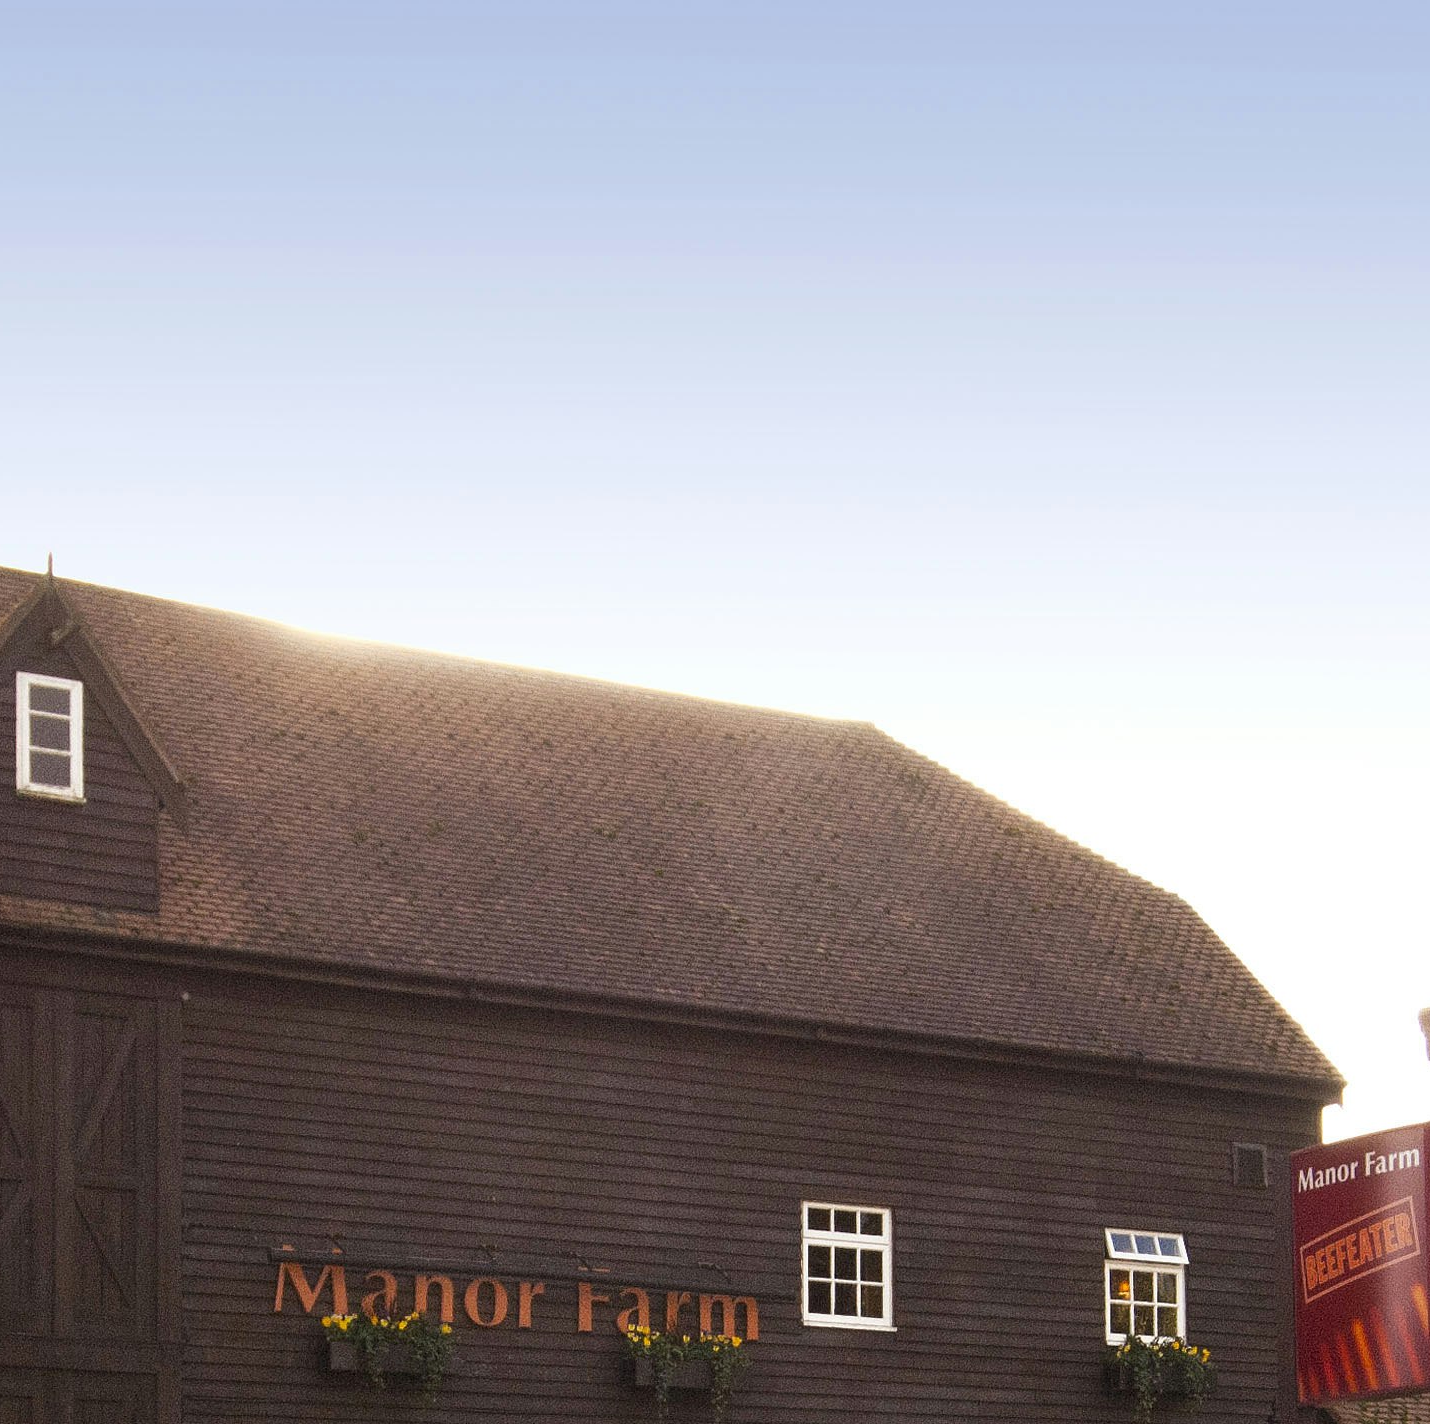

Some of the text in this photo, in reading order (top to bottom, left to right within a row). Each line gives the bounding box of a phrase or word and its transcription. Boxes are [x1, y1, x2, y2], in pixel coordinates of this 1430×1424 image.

[1298, 1148, 1420, 1193] Manor Farm
[1305, 1212, 1415, 1290] BEEFEATER
[274, 1244, 759, 1341] Manor Farm
